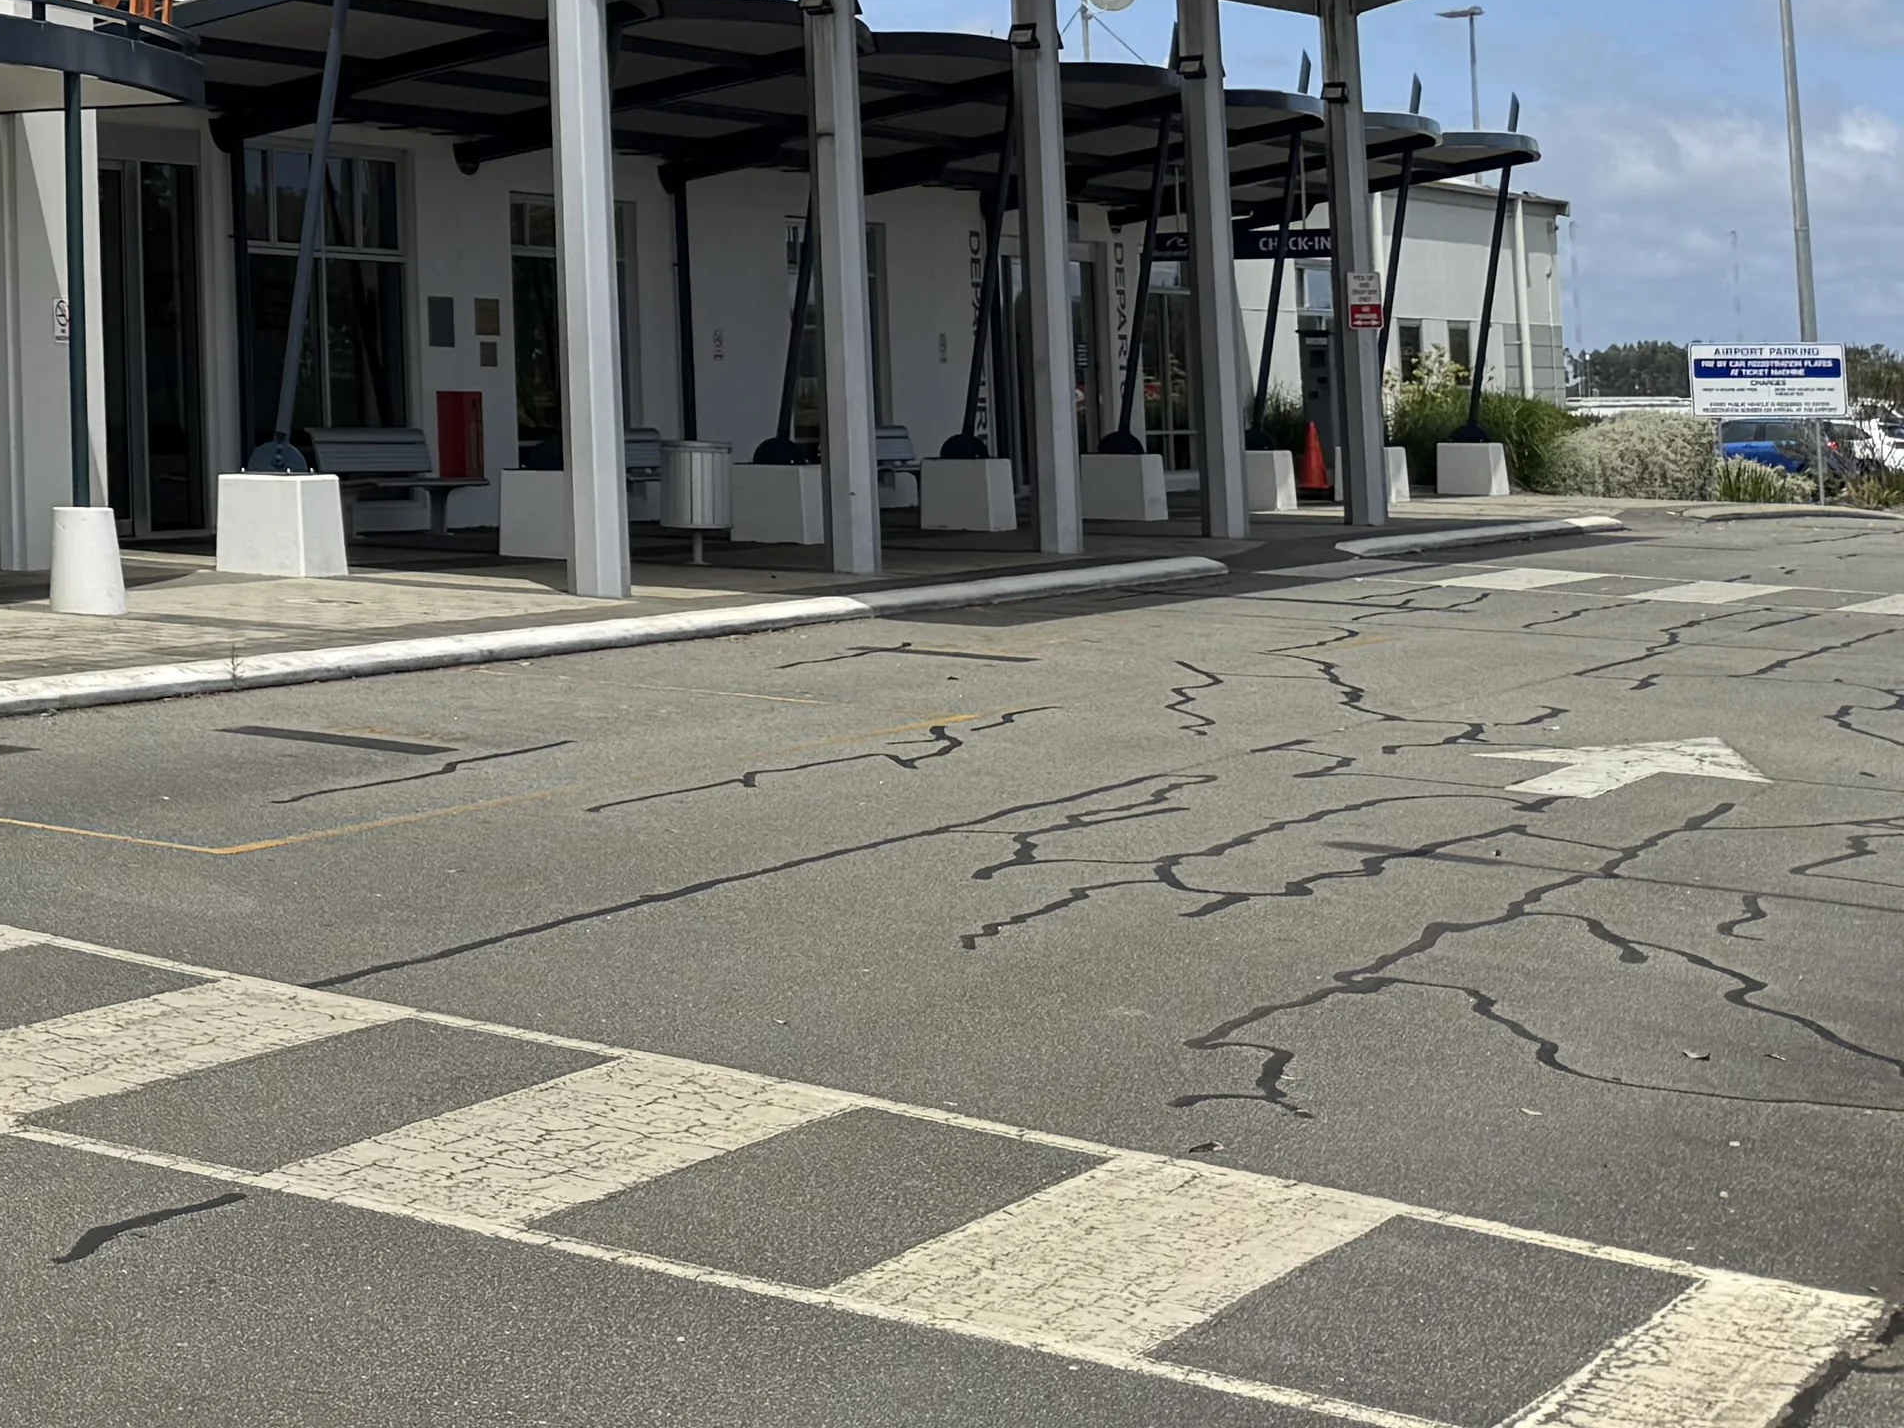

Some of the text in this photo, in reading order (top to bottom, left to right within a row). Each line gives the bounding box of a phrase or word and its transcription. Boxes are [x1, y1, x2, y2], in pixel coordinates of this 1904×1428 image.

[1259, 236, 1331, 252] CHCK-IN
[1714, 347, 1819, 356] AIRPORT PARKING
